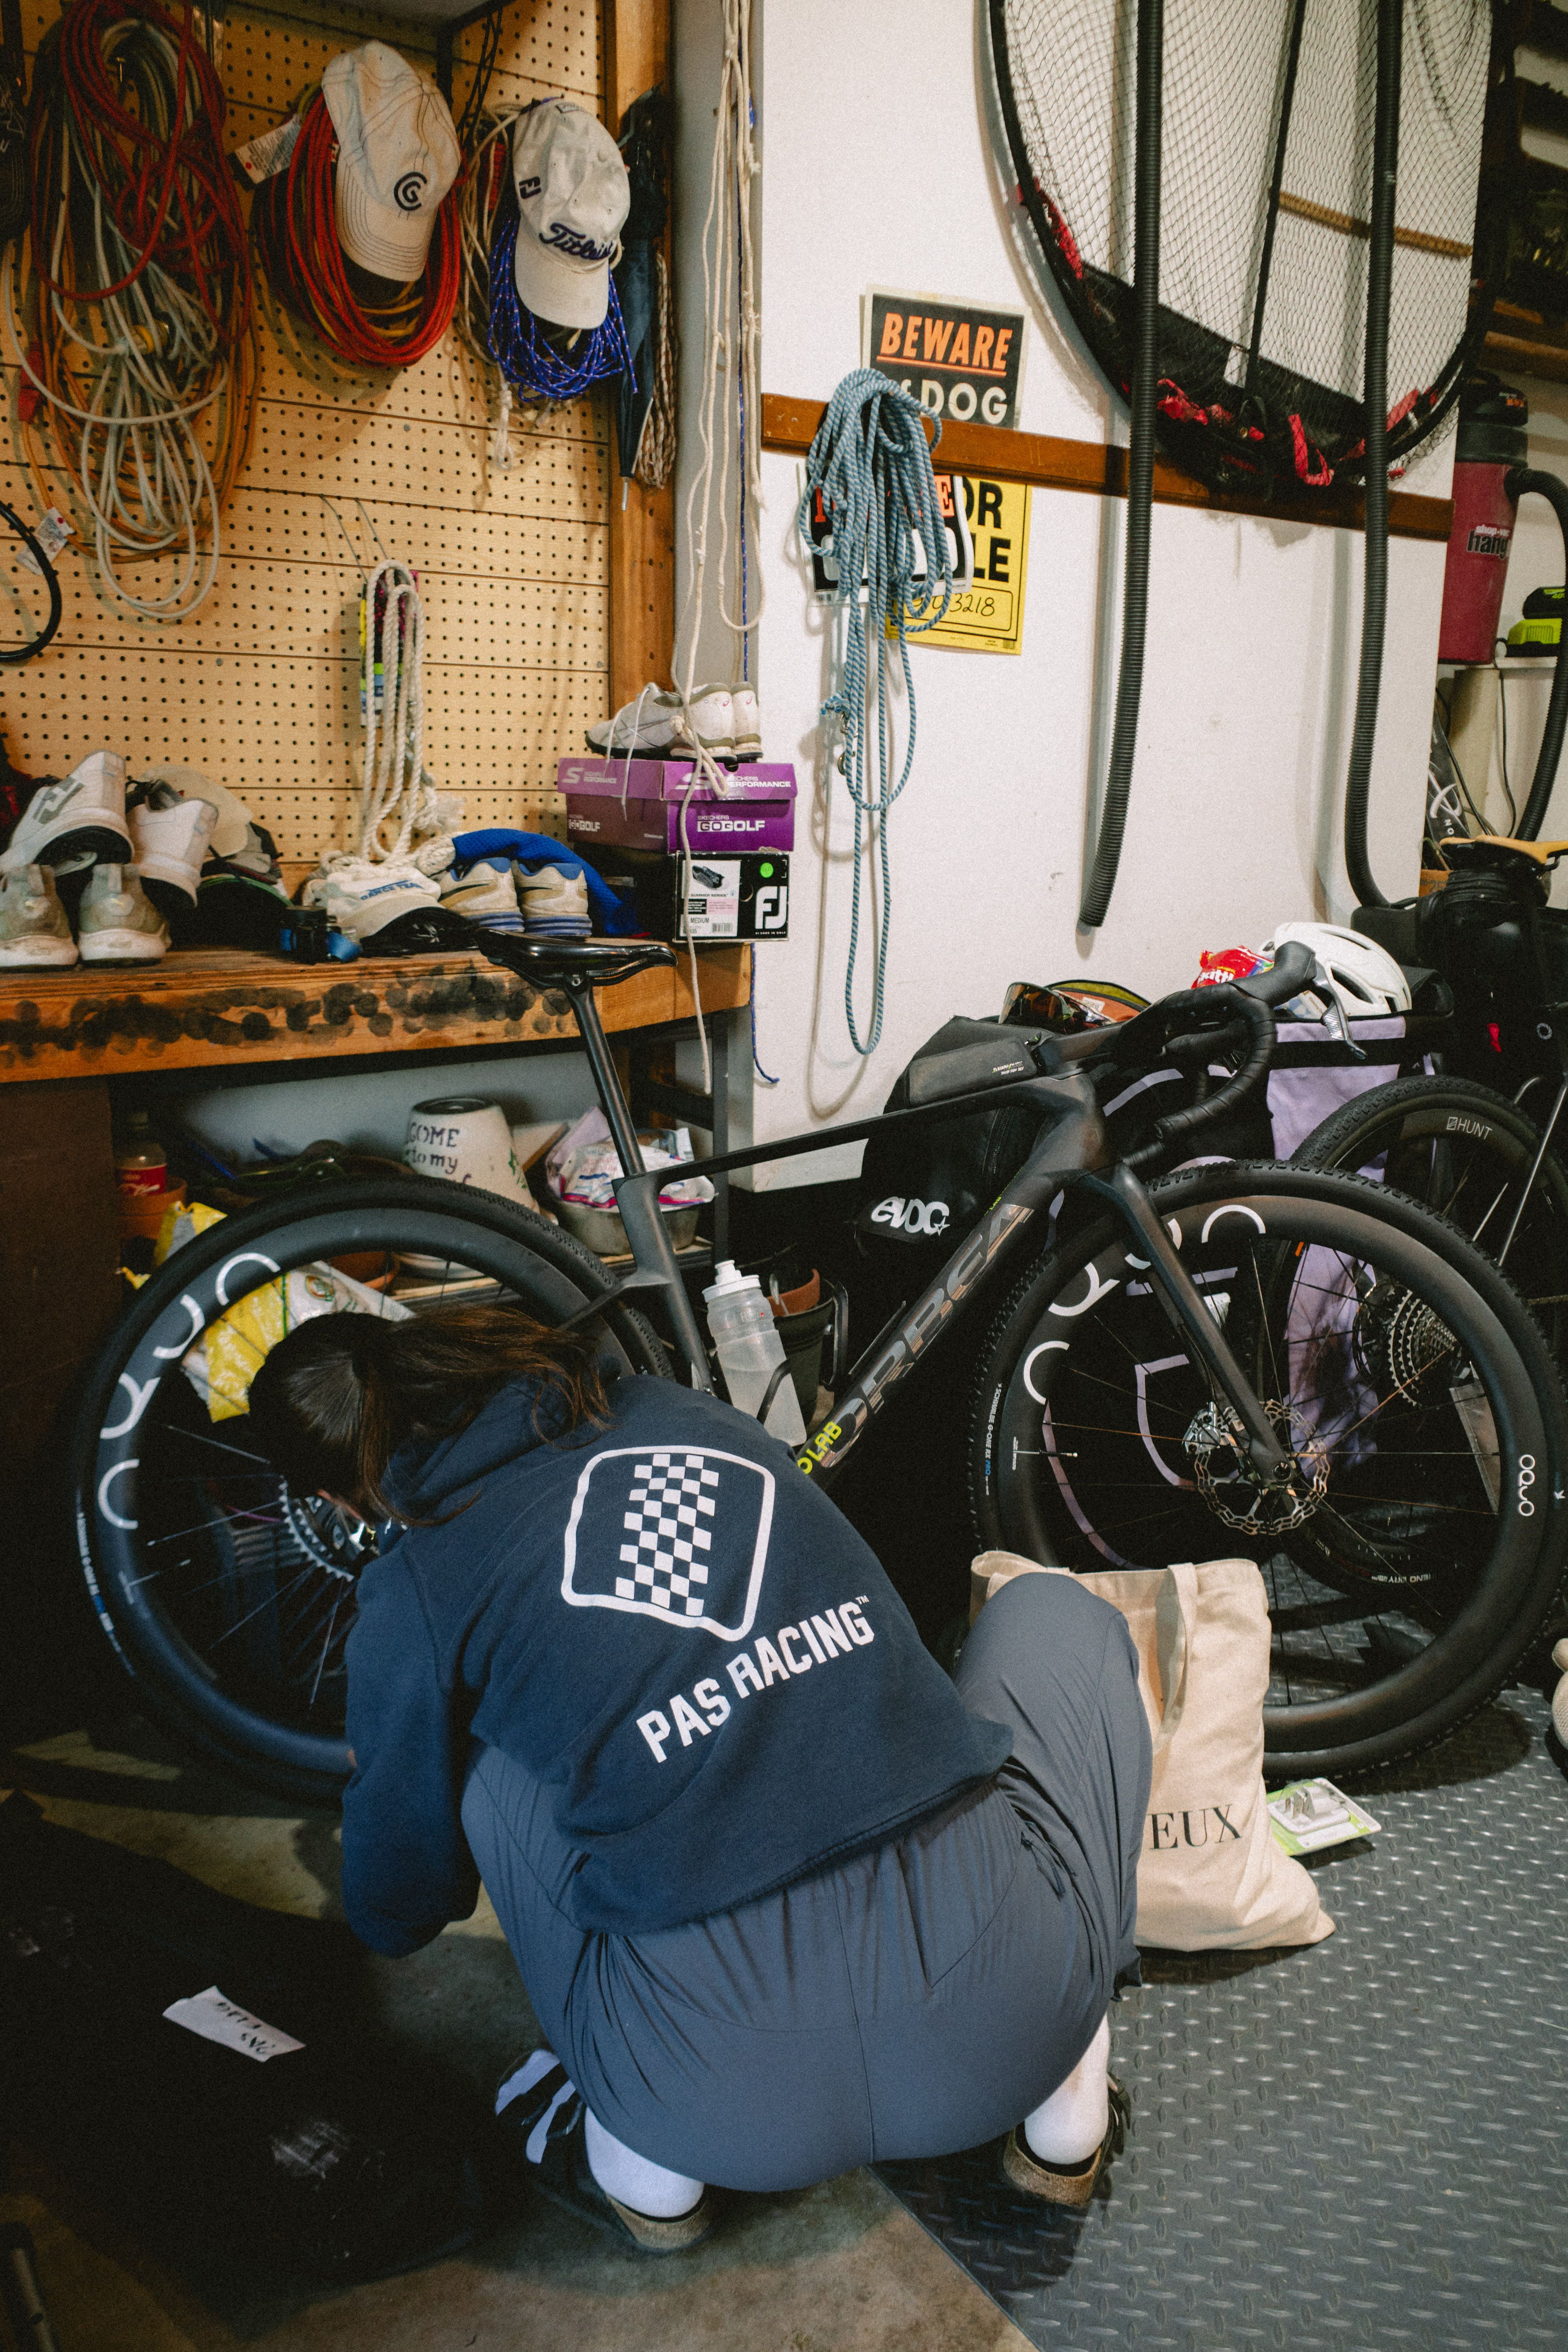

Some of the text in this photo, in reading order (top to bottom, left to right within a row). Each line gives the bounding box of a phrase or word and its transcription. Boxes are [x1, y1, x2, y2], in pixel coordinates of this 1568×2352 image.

[880, 312, 1013, 370] BEWARE
[920, 379, 1007, 425] DOG
[950, 593, 995, 616] 3218
[755, 886, 788, 929] FJ
[1457, 1118, 1493, 1140] HUNT
[430, 1154, 458, 1174] my
[817, 1203, 1035, 1468] ORBEA
[988, 1388, 1002, 1424] SCHWALBE
[806, 1421, 842, 1461] LAB
[985, 1448, 991, 1459] RX
[636, 1677, 731, 1763] PAS
[1147, 1804, 1243, 1850] EUX
